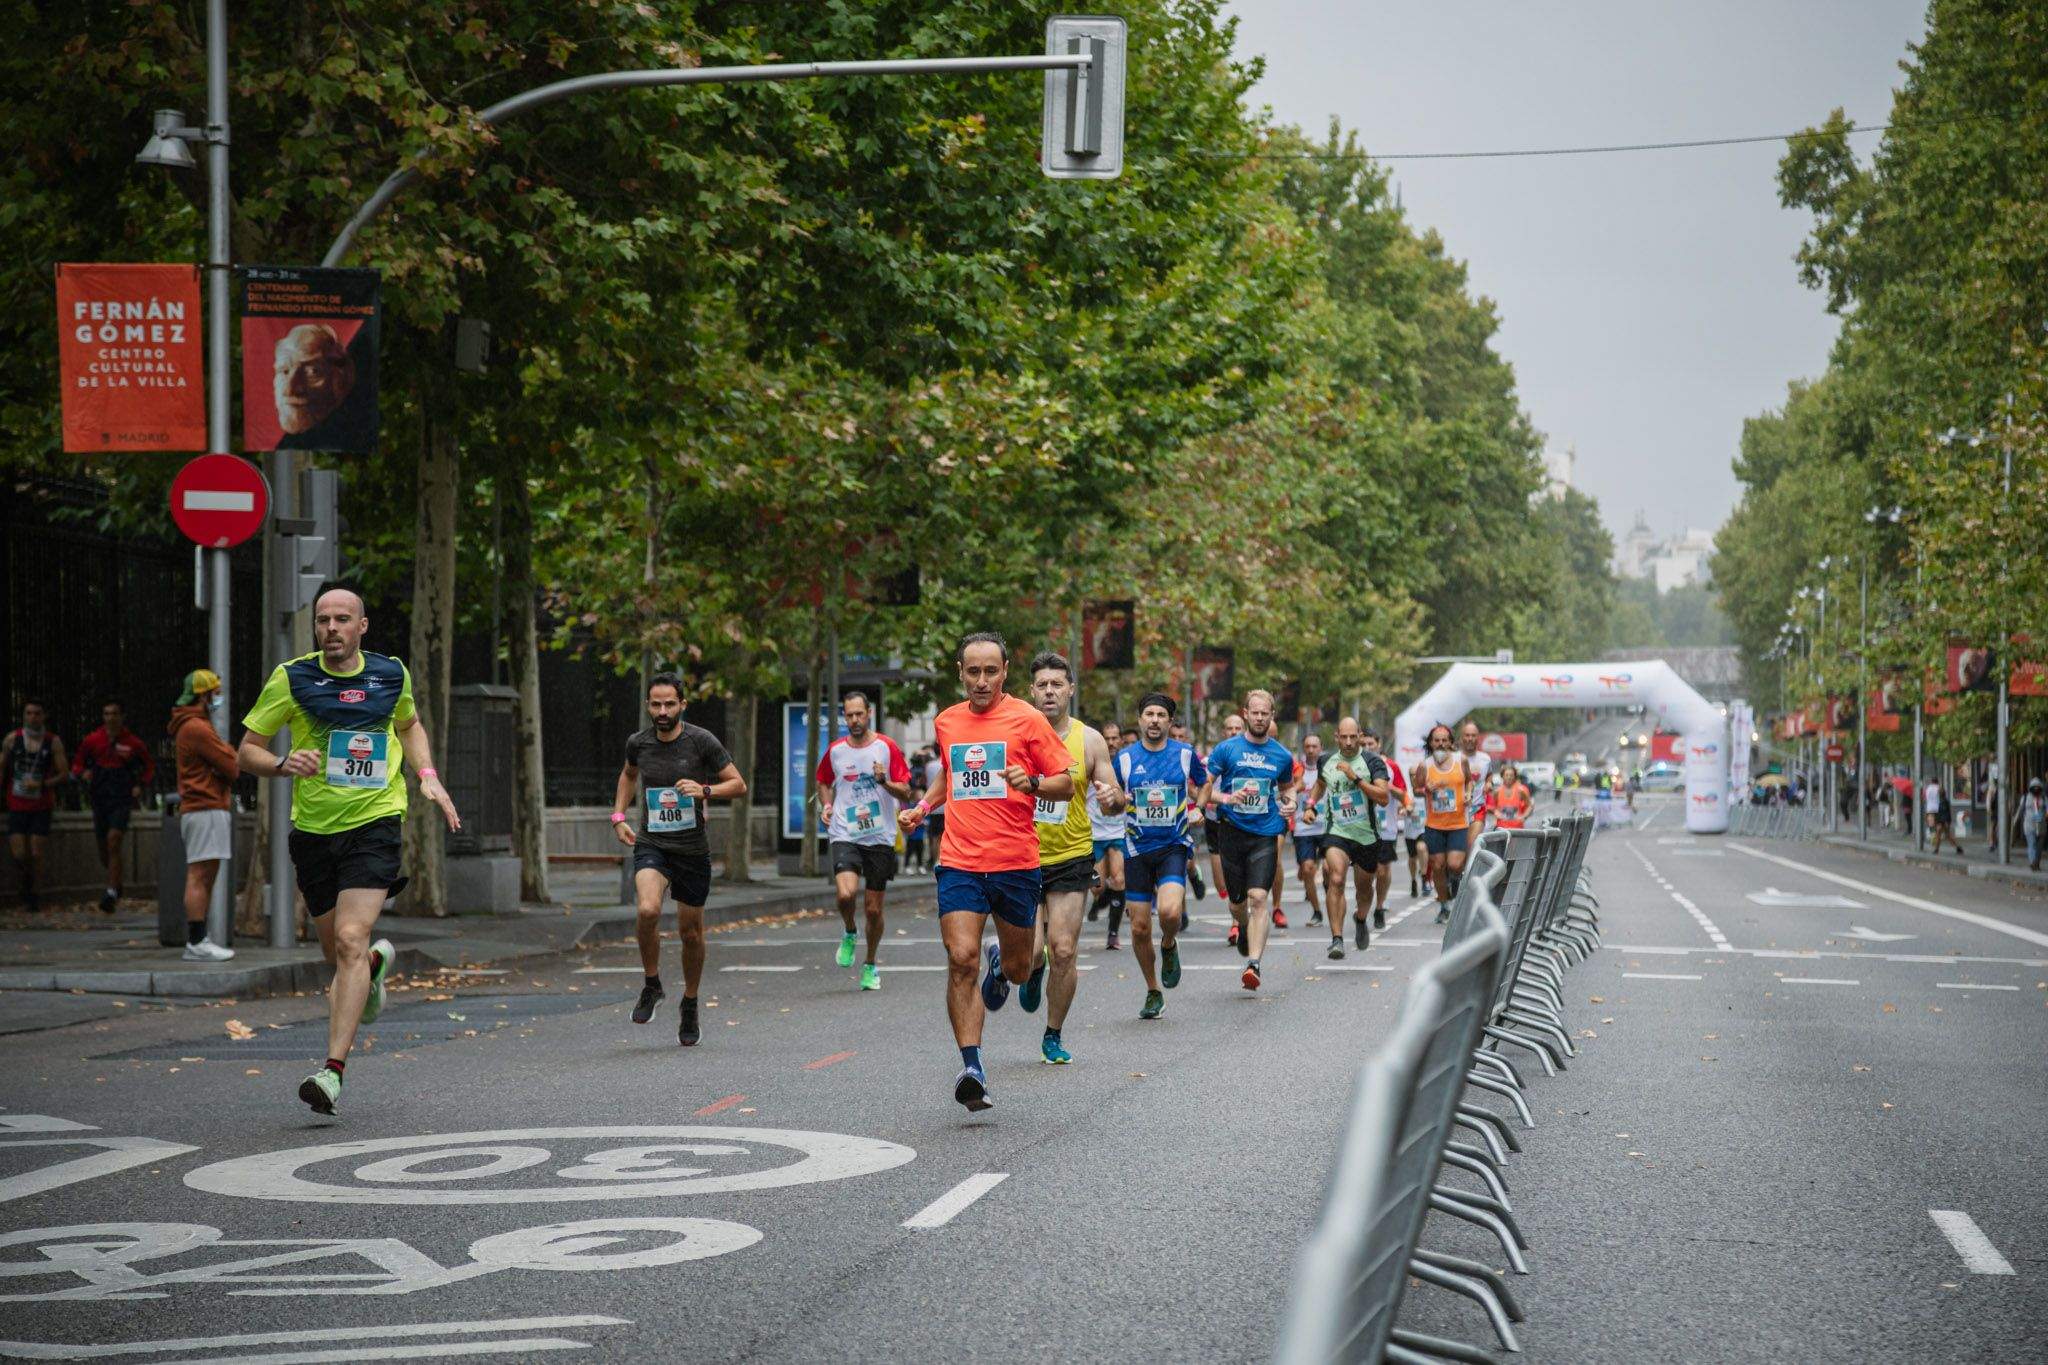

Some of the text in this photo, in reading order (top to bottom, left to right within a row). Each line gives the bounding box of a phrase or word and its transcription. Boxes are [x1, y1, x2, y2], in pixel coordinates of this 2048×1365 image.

[247, 283, 309, 292] CENTENARIO
[247, 292, 341, 304] DEL NACIMIENTO DE
[74, 297, 185, 320] FERNÁN
[247, 302, 300, 312] FERNANDO
[75, 321, 186, 343] GÓMEZ
[98, 348, 166, 360] CENTRO
[88, 362, 176, 373] CULTURAL
[78, 377, 187, 387] DE LA VILLA
[117, 432, 170, 443] MADRID
[345, 759, 373, 776] 370
[962, 770, 990, 788] 389
[1034, 800, 1055, 813] 90
[1145, 806, 1169, 819] 1231
[659, 809, 682, 822] 408
